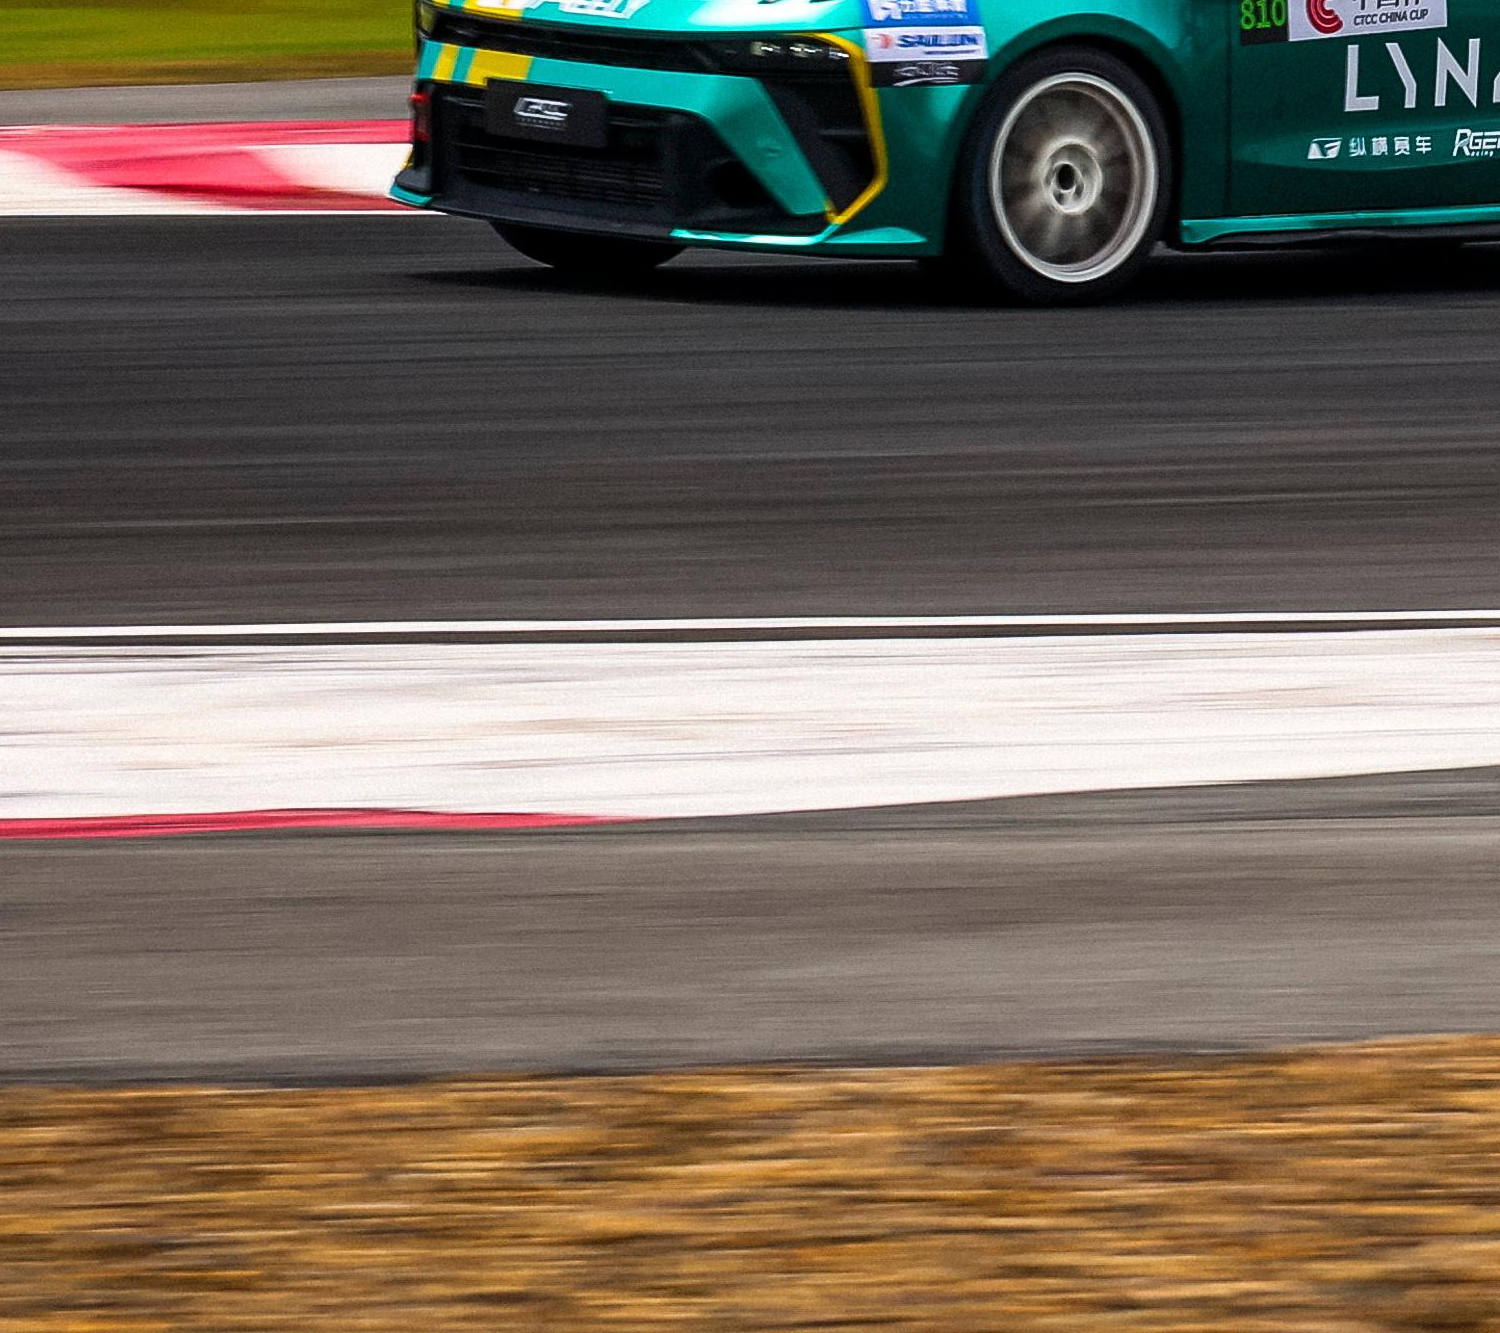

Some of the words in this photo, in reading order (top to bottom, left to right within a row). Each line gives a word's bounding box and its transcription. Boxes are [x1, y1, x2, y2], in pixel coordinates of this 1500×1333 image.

[1353, 13, 1378, 26] CTCC
[1378, 10, 1408, 23] CHINA
[1409, 8, 1429, 20] CUP
